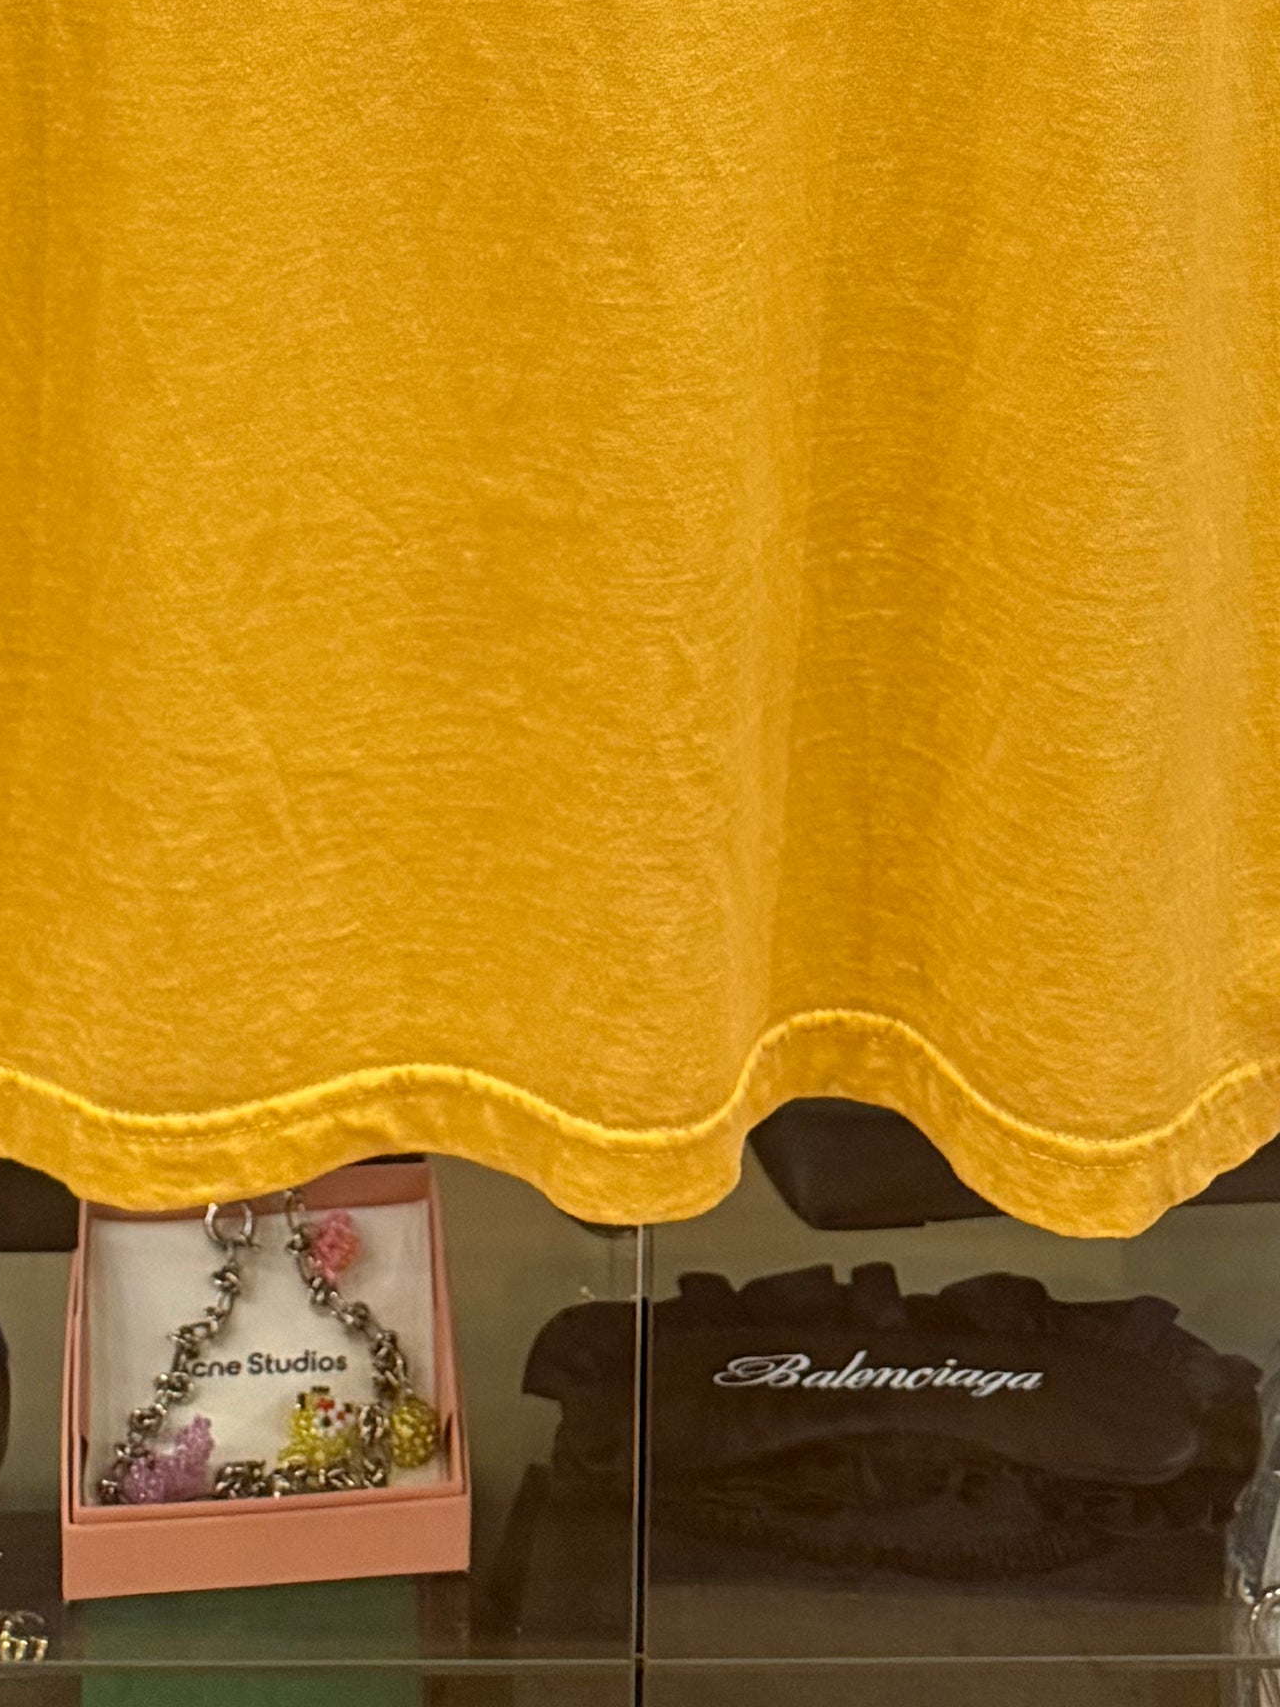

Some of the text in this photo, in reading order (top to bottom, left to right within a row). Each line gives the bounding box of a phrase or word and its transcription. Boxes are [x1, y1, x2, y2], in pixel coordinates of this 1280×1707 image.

[182, 1350, 348, 1378] cne Studios
[713, 1350, 1044, 1397] Balenciaga
